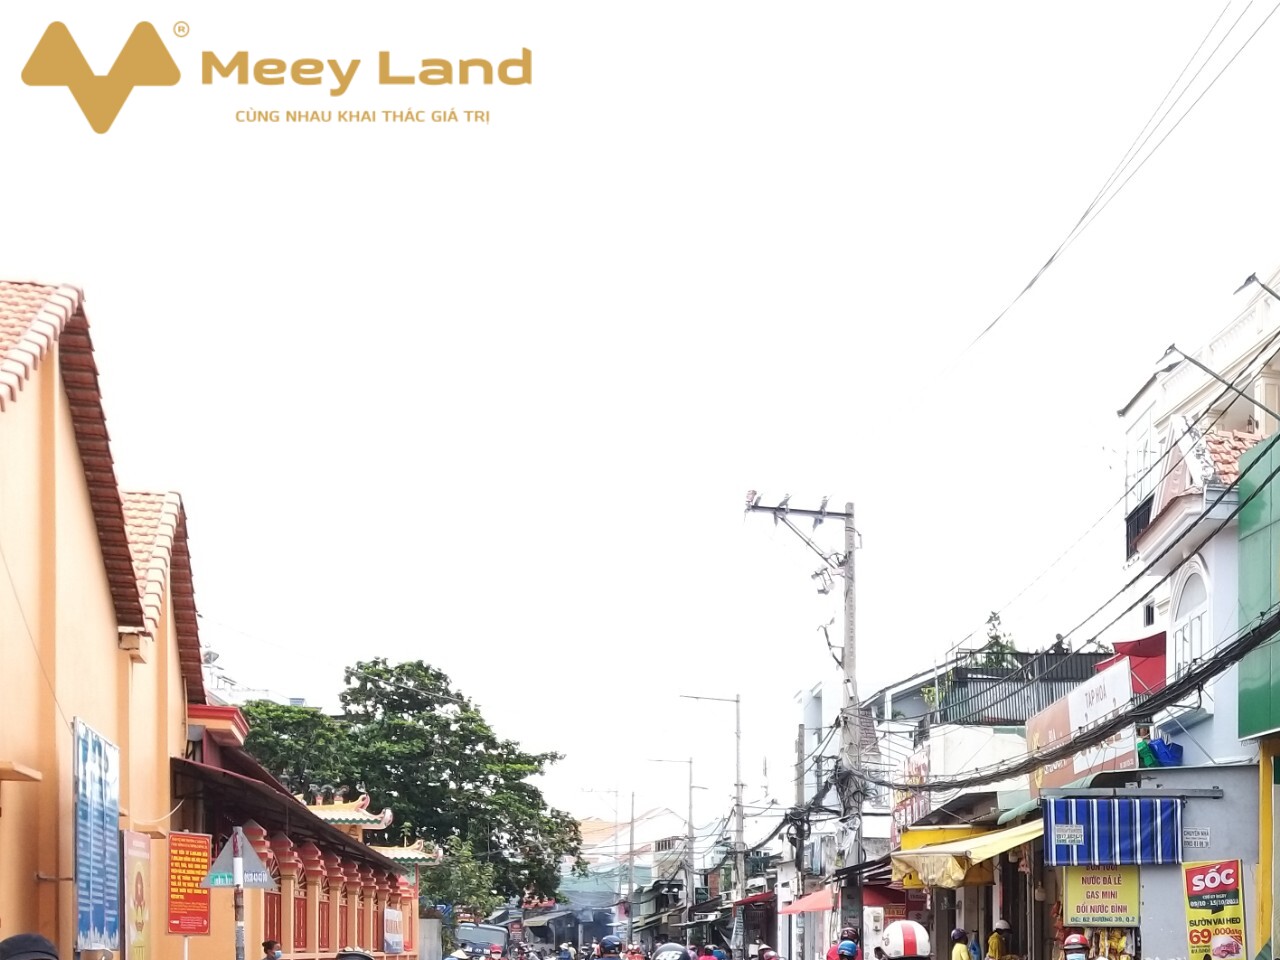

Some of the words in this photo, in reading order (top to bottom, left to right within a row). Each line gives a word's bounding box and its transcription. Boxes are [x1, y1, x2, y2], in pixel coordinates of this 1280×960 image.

[1081, 874, 1101, 885] NƯỚC
[1191, 866, 1235, 892] SỐC
[1086, 890, 1100, 900] GAS
[1102, 890, 1118, 899] MINI
[1090, 903, 1109, 914] NƯỚC
[1226, 916, 1241, 925] HEO
[1189, 928, 1212, 945] 69
[655, 950, 683, 960] 46
